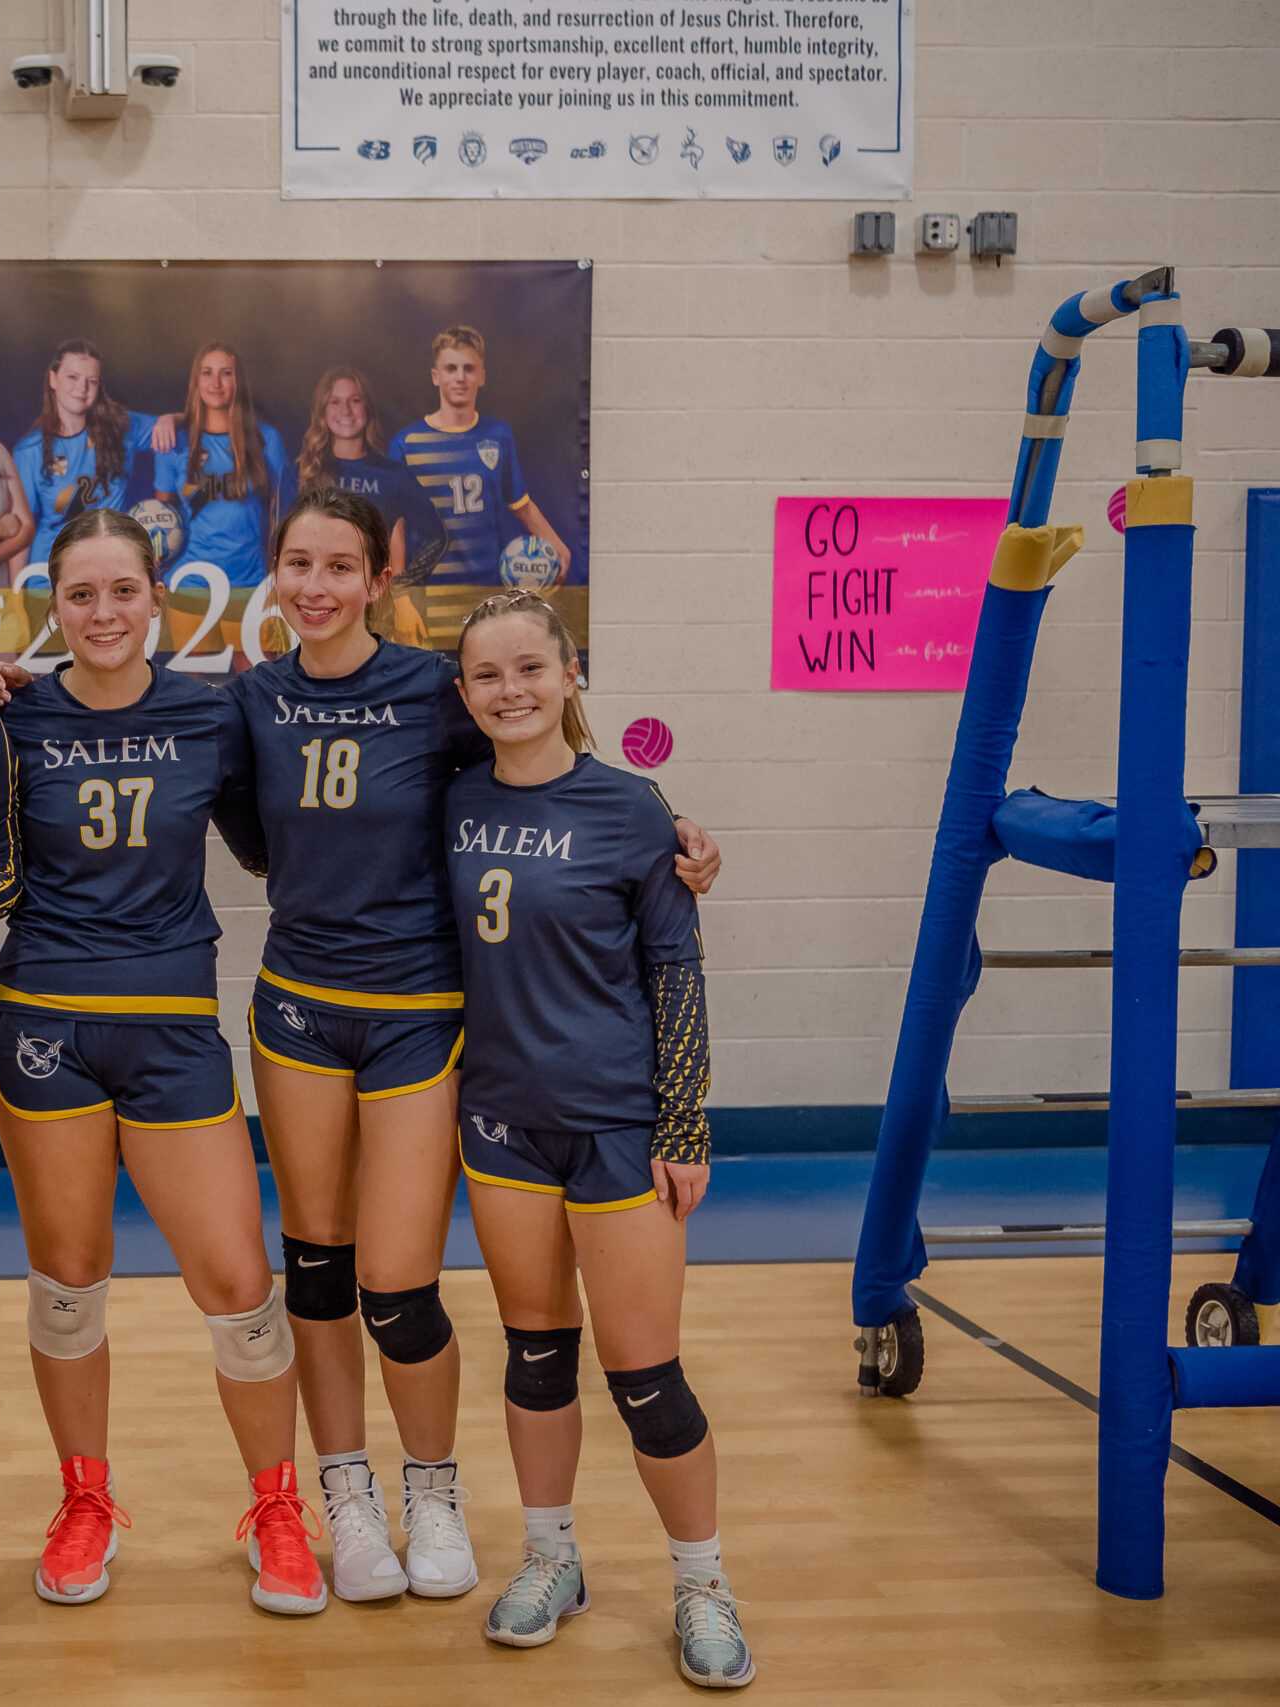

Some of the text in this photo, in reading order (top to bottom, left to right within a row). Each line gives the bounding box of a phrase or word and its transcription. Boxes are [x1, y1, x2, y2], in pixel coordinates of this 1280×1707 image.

[334, 8, 863, 30] through the life, death, and resurrection of Jesus Christ. Therefore,
[318, 35, 878, 58] we commit to strong sportsmanship, excellent effort, humble integrity,
[309, 61, 887, 84] and unconditional respect for every player, coach, official, and spectator.
[400, 88, 798, 110] We appreciate your joining us in this commitment.
[332, 476, 380, 494] LEM
[449, 474, 484, 514] 12
[805, 504, 859, 557] GO
[513, 562, 548, 574] SELECT
[808, 568, 898, 619] FIGHT
[13, 561, 298, 674] 226
[799, 628, 875, 673] WIN
[923, 641, 964, 661] fight
[42, 735, 180, 769] SALEM
[299, 738, 361, 809] 18
[78, 776, 154, 850] 37
[454, 819, 573, 861] SALEM
[477, 868, 513, 943] 3
